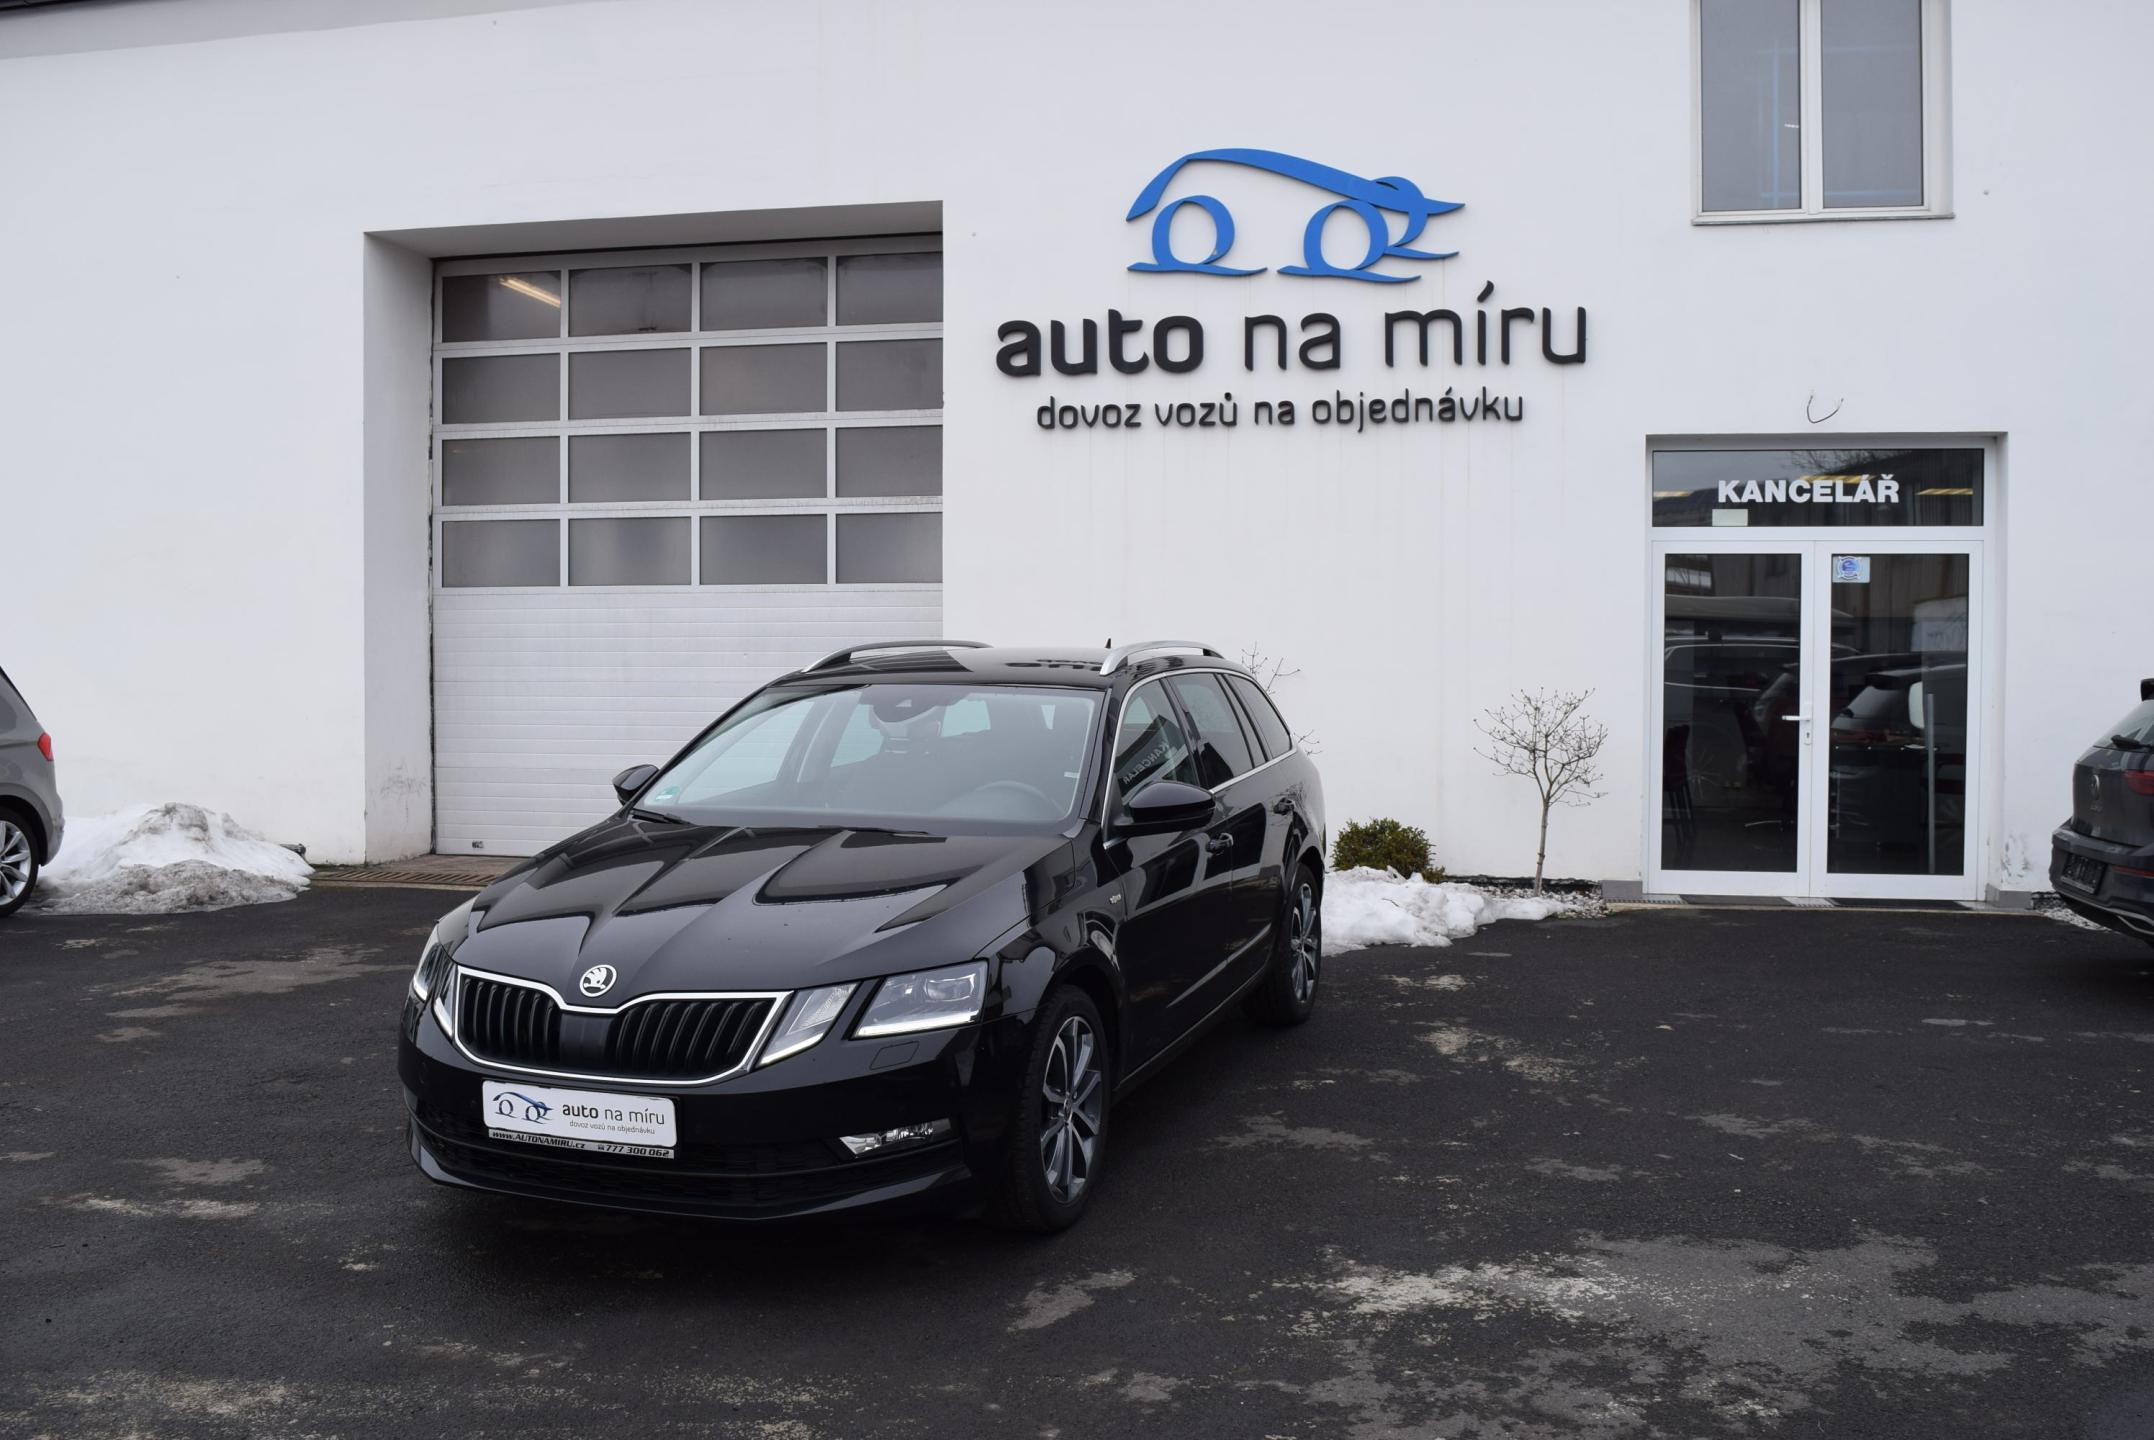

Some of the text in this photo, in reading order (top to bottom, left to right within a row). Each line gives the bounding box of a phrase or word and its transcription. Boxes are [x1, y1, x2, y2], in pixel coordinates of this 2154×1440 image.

[995, 280, 1587, 379] auto na míru
[1036, 386, 1523, 434] dovoz vozů na objednávku
[1717, 473, 1899, 503] KANCELÁŘ
[562, 1104, 665, 1125] auto na míru
[569, 1119, 589, 1129] dovoz
[605, 1144, 624, 1153] 777
[626, 1146, 647, 1156] 300
[648, 1148, 670, 1157] 062
